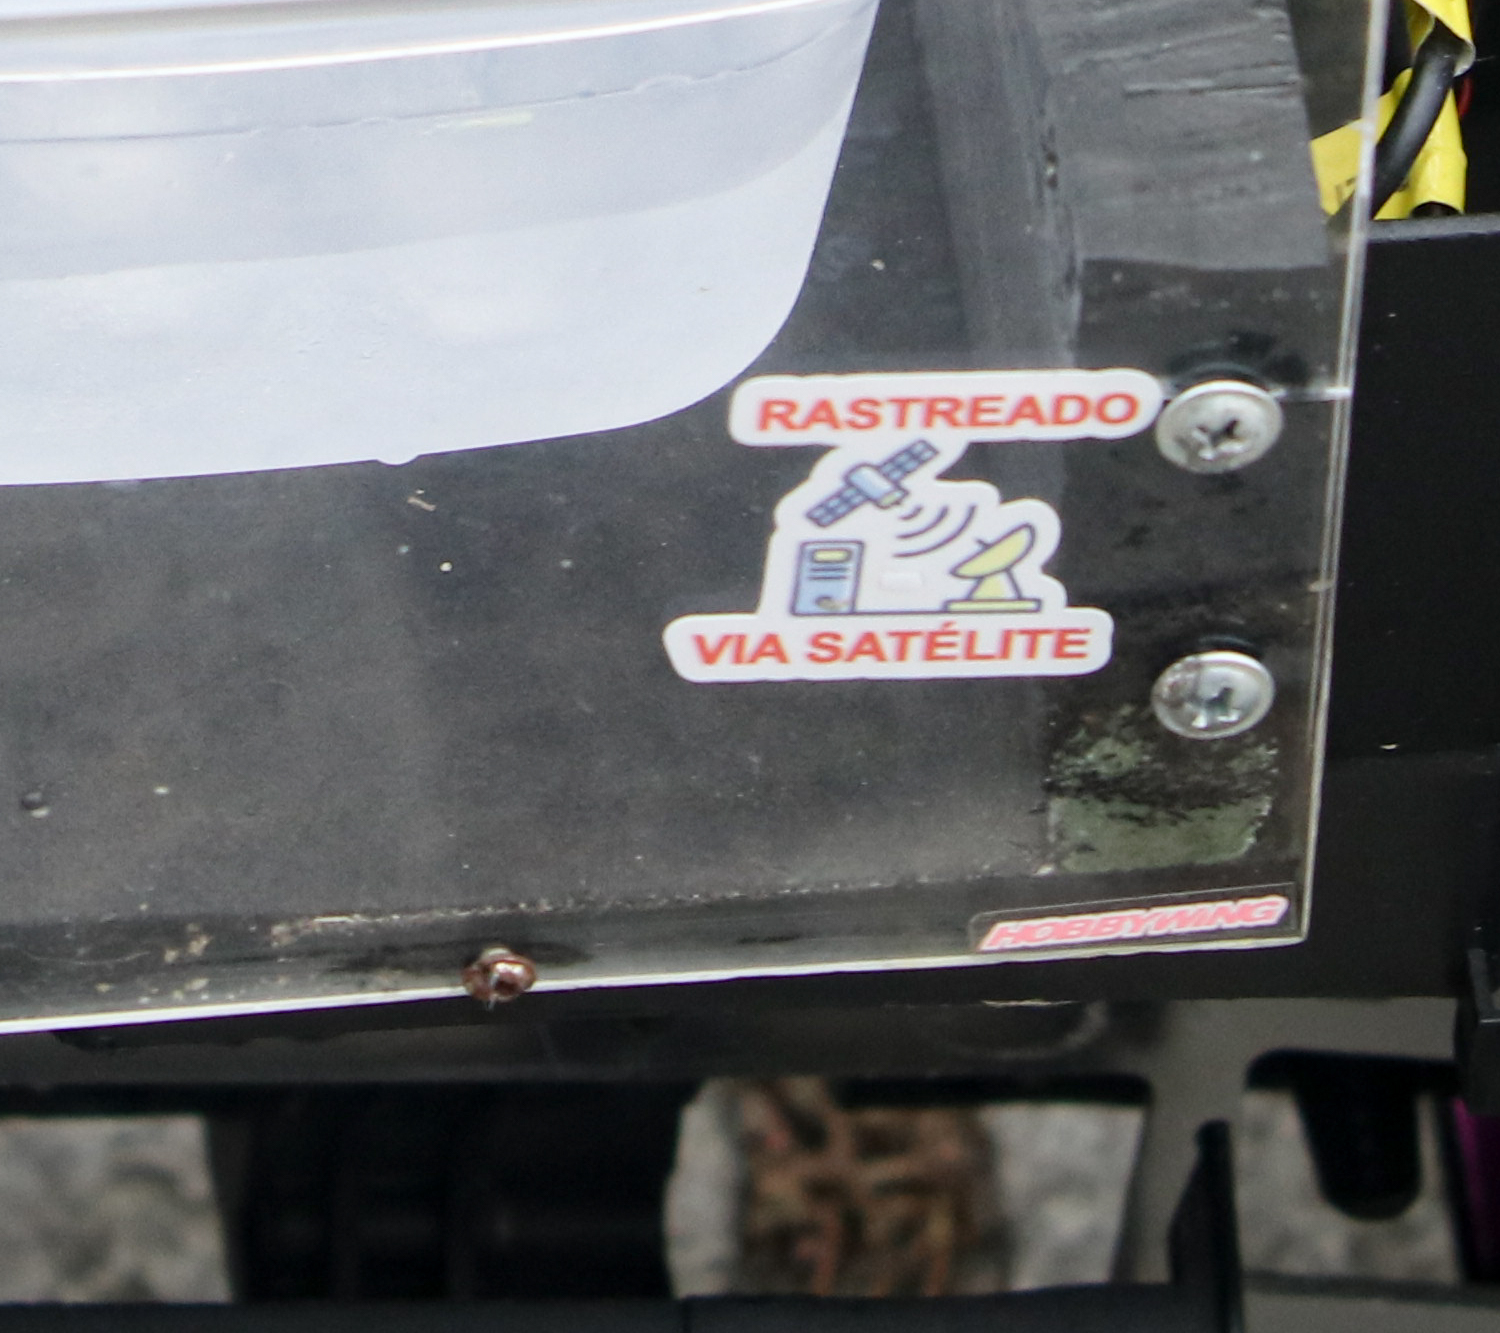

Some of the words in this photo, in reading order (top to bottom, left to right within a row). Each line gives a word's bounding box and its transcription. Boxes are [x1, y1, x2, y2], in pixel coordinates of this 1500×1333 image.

[757, 391, 1141, 432] RASTREADO
[692, 633, 789, 665] VIA
[806, 621, 1092, 662] SATÉLITE
[982, 896, 1287, 950] HOBBYWING
